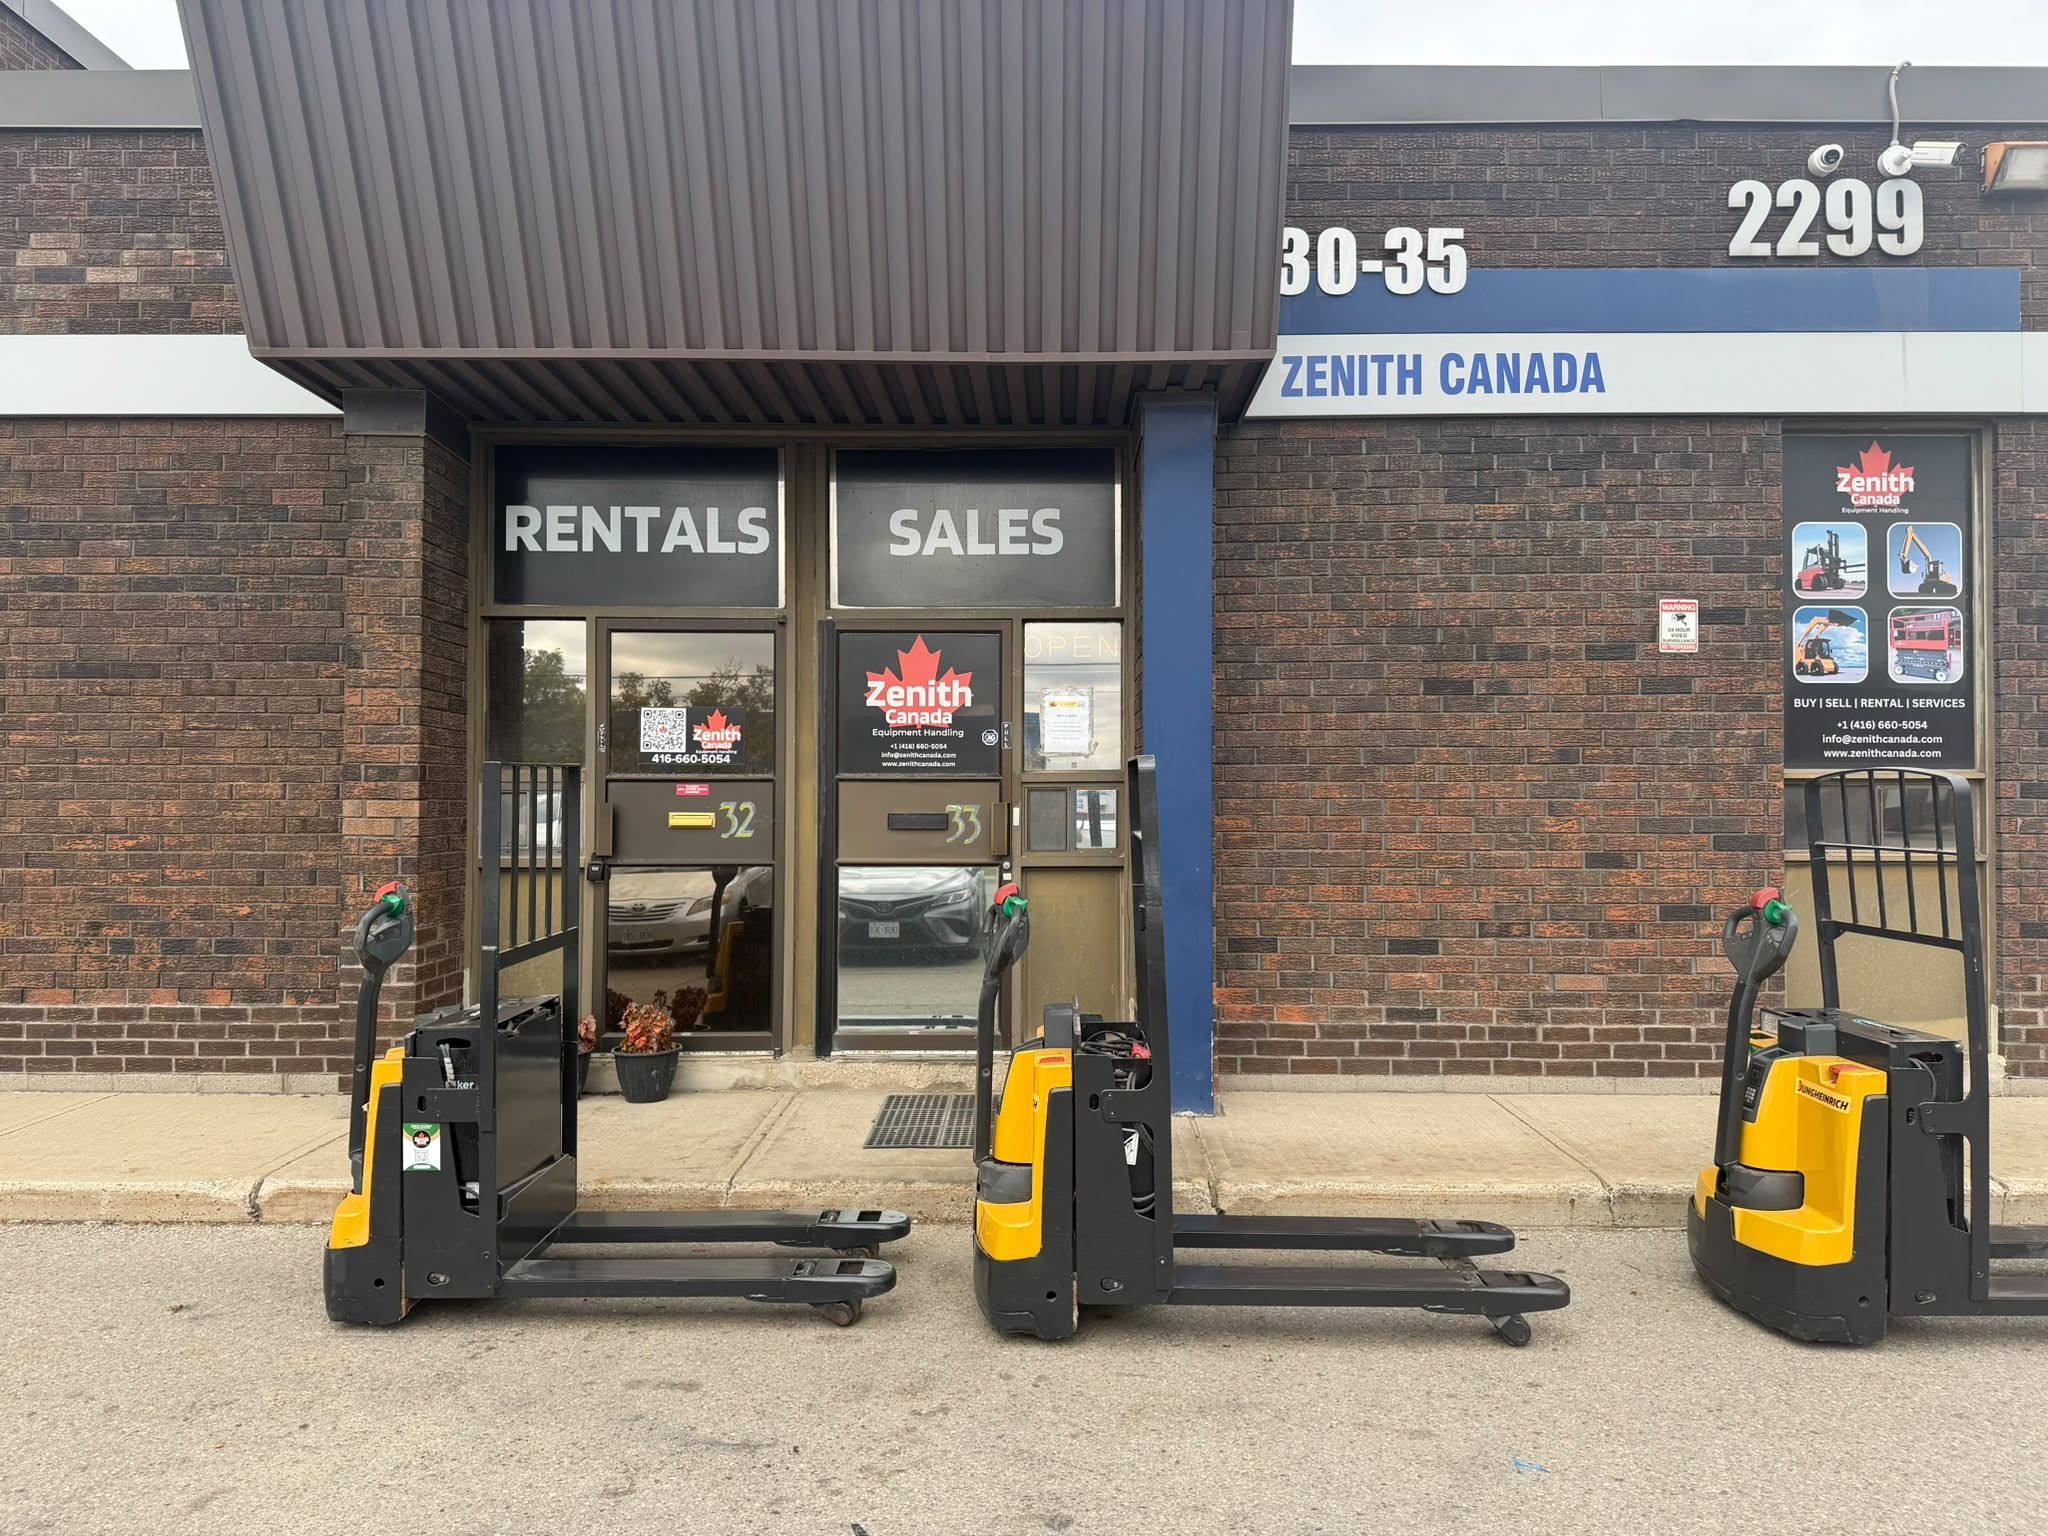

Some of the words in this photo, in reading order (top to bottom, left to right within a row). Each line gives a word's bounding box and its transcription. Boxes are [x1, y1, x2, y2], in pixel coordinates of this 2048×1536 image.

[1728, 178, 1924, 257] 2299
[1280, 226, 1467, 296] 30-35
[1281, 354, 1422, 397] ZENITH
[1440, 352, 1606, 395] CANADA
[1836, 472, 1915, 492] Zenith
[1851, 493, 1900, 505] Canada
[505, 505, 771, 555] RENTALS
[889, 508, 1064, 556] SALES
[1662, 603, 1696, 611] WARNING
[1024, 634, 1119, 658] OPEN
[866, 680, 972, 707] Zenith
[1794, 698, 1817, 708] BUY
[1825, 698, 1852, 708] SELL
[1860, 698, 1903, 708] RENTAL
[1912, 698, 1966, 708] SERVICES
[885, 709, 953, 724] Canada
[1837, 721, 1848, 729] +1
[1850, 720, 1876, 730] (416)
[1878, 720, 1928, 730] 660-5054
[693, 728, 742, 742] Zenith
[872, 728, 922, 738] Equipment
[923, 728, 964, 738] Handling
[1822, 734, 1943, 744] info@zenithcanada.com
[701, 741, 733, 750] Canada
[1823, 748, 1942, 758] www.zenithcanada.com
[651, 753, 731, 764] 416-660-5054
[719, 801, 756, 839] 32
[945, 804, 981, 844] 33
[1797, 1079, 1849, 1111] JUNGHEINRICH
